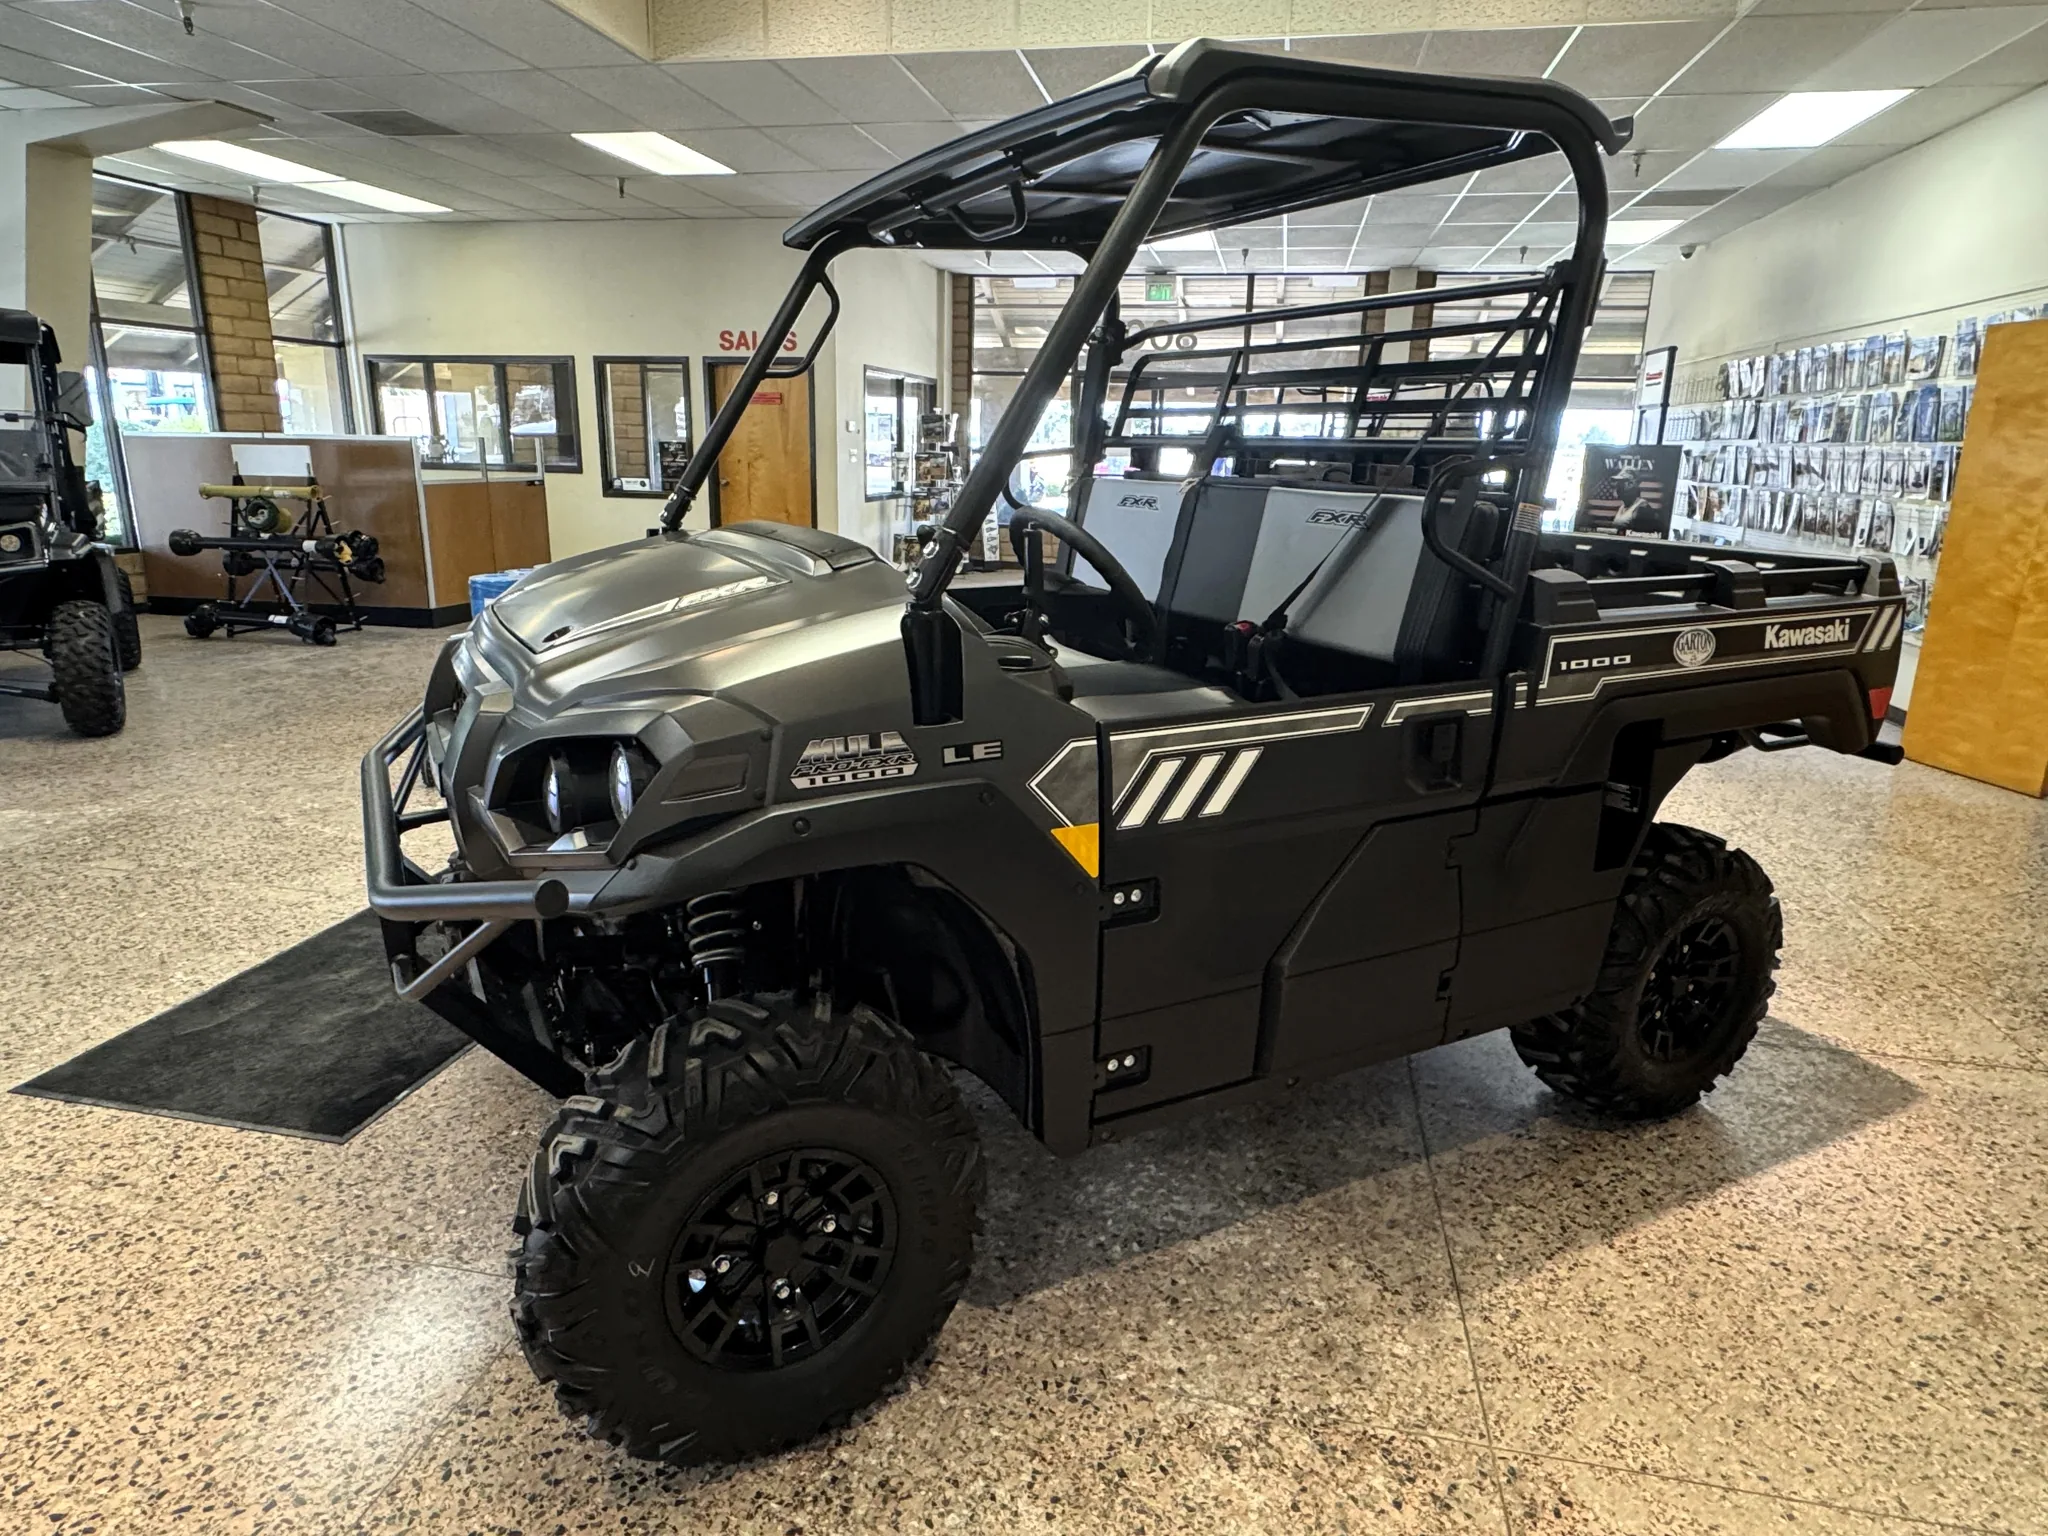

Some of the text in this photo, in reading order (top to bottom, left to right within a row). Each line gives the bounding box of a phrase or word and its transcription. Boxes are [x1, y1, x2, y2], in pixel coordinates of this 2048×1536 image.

[1764, 618, 1850, 649] Kawasaki
[1560, 655, 1631, 671] 1000
[943, 741, 1002, 764] LE
[808, 767, 904, 786] 1000
